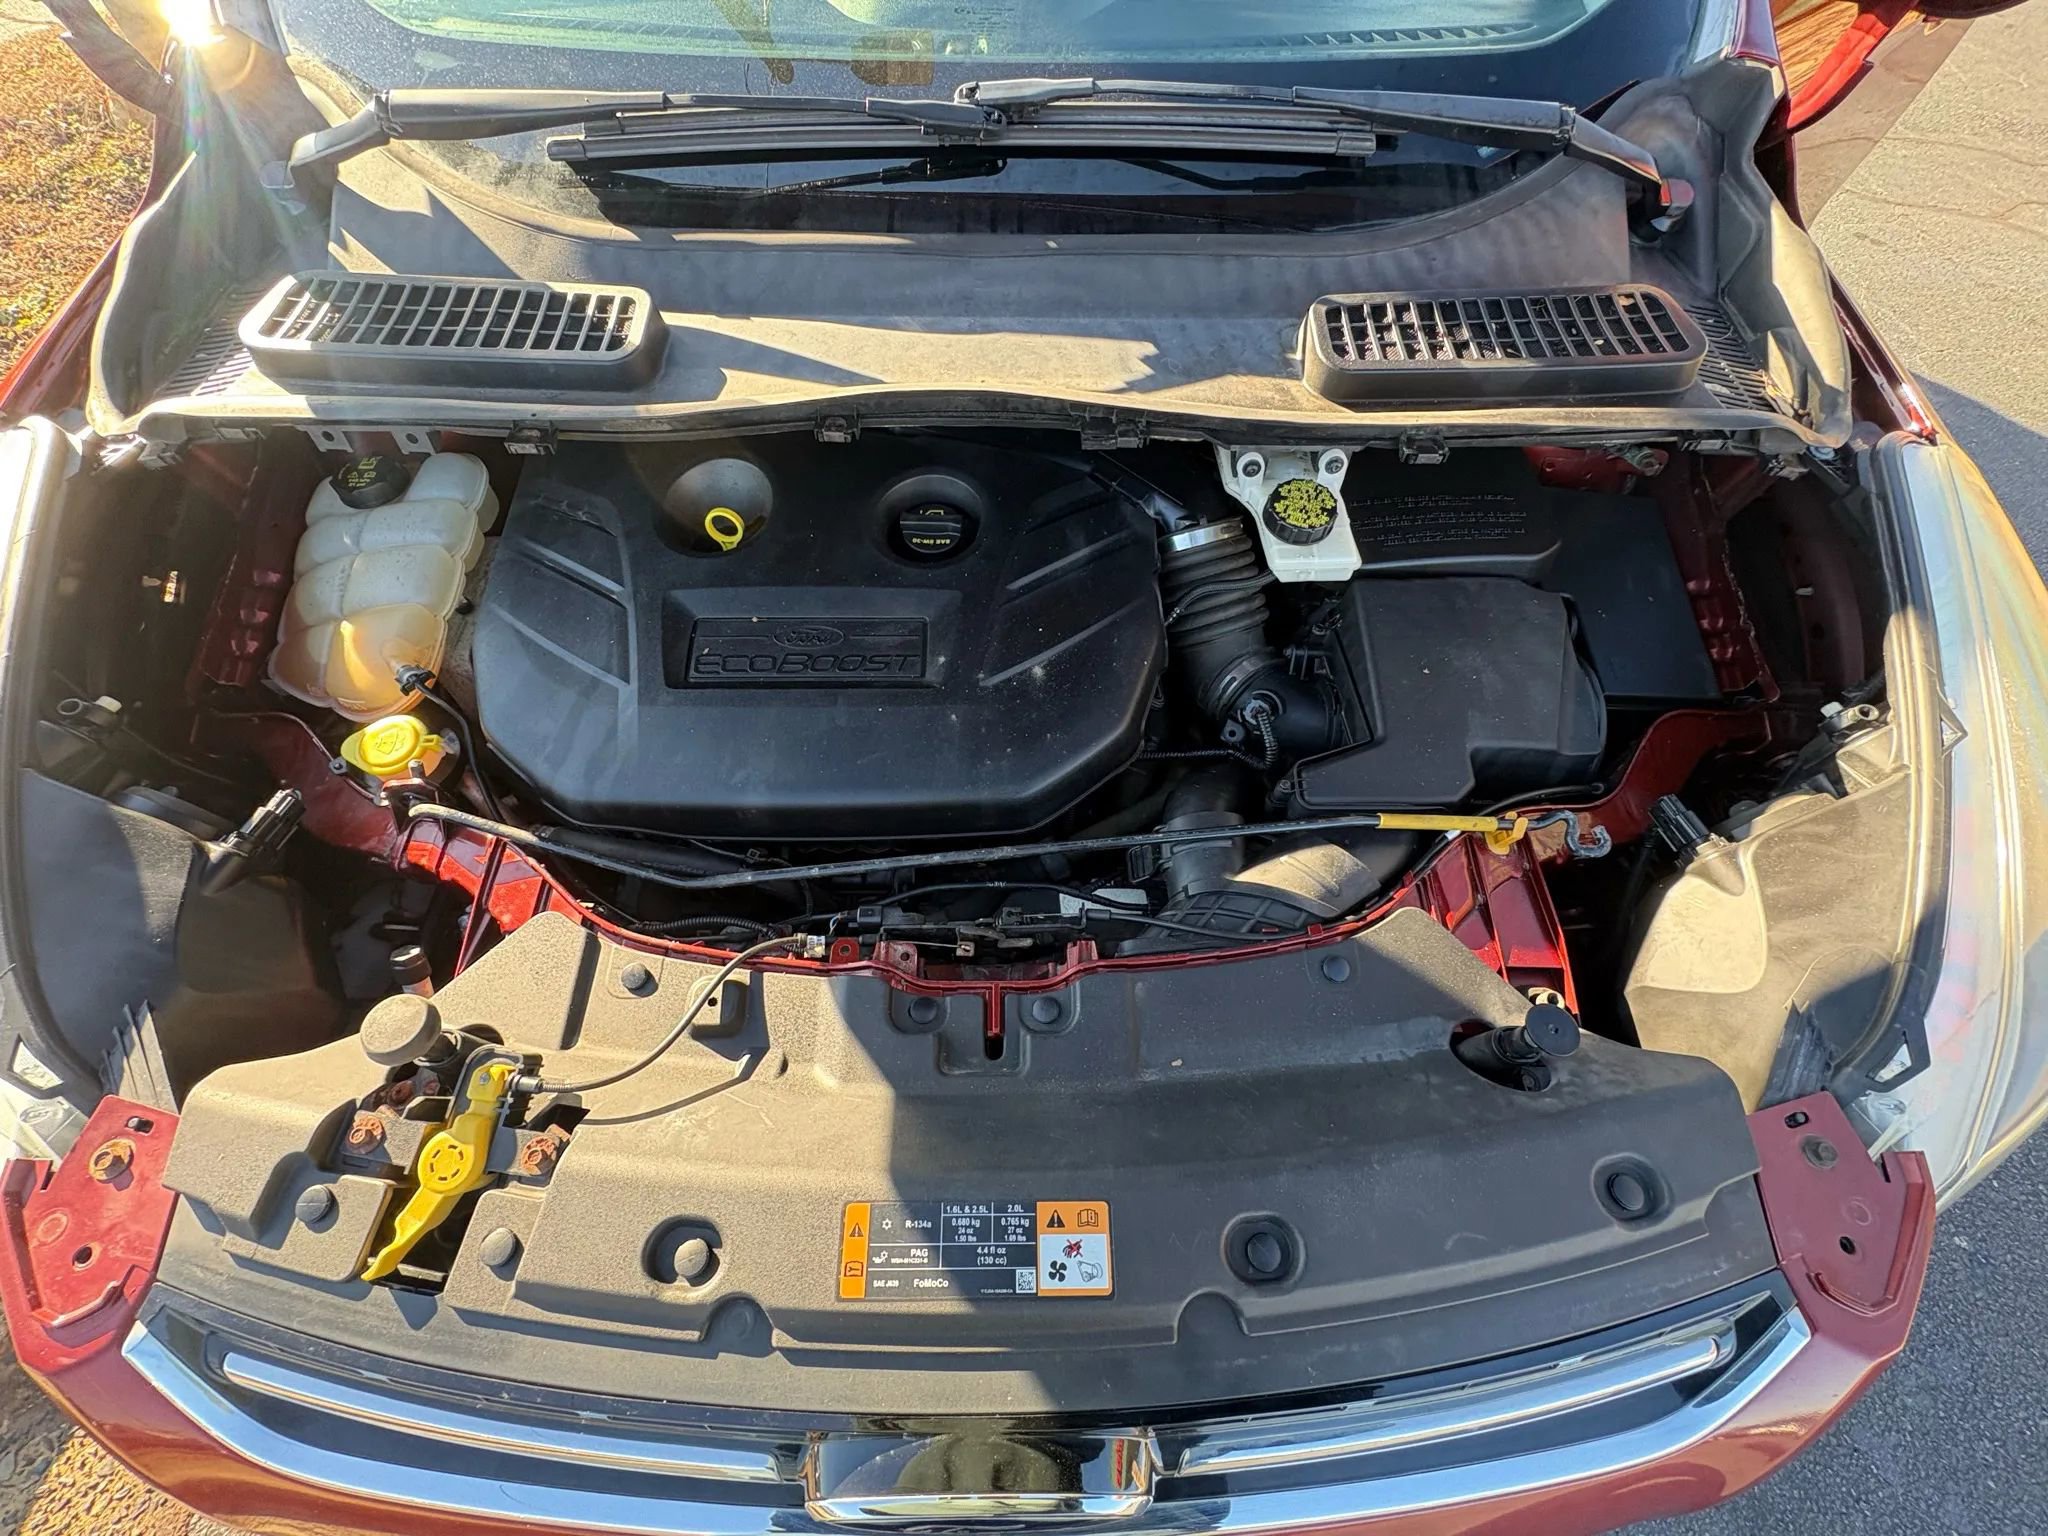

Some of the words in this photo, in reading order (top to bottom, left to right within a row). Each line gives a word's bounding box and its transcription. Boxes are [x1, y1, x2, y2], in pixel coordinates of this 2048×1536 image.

[946, 1204, 962, 1214] 1.6L
[964, 1205, 971, 1213] &
[972, 1204, 989, 1214] 2.5L
[1007, 1204, 1024, 1213] 2.0L
[905, 1219, 932, 1229] R-134a
[951, 1217, 970, 1227] 0.680
[971, 1217, 981, 1229] kg
[1001, 1217, 1019, 1227] 0.765
[1020, 1217, 1030, 1229] kg
[958, 1227, 966, 1235] 24
[1007, 1226, 1015, 1234] 27
[910, 1248, 929, 1257] PAG
[976, 1246, 989, 1255] 4.4
[989, 1246, 997, 1255] fl
[997, 1247, 1007, 1255] oz
[977, 1256, 994, 1266] (130
[994, 1256, 1007, 1265] cc)
[872, 1279, 885, 1288] SAE
[913, 1278, 949, 1288] FoMoCo
